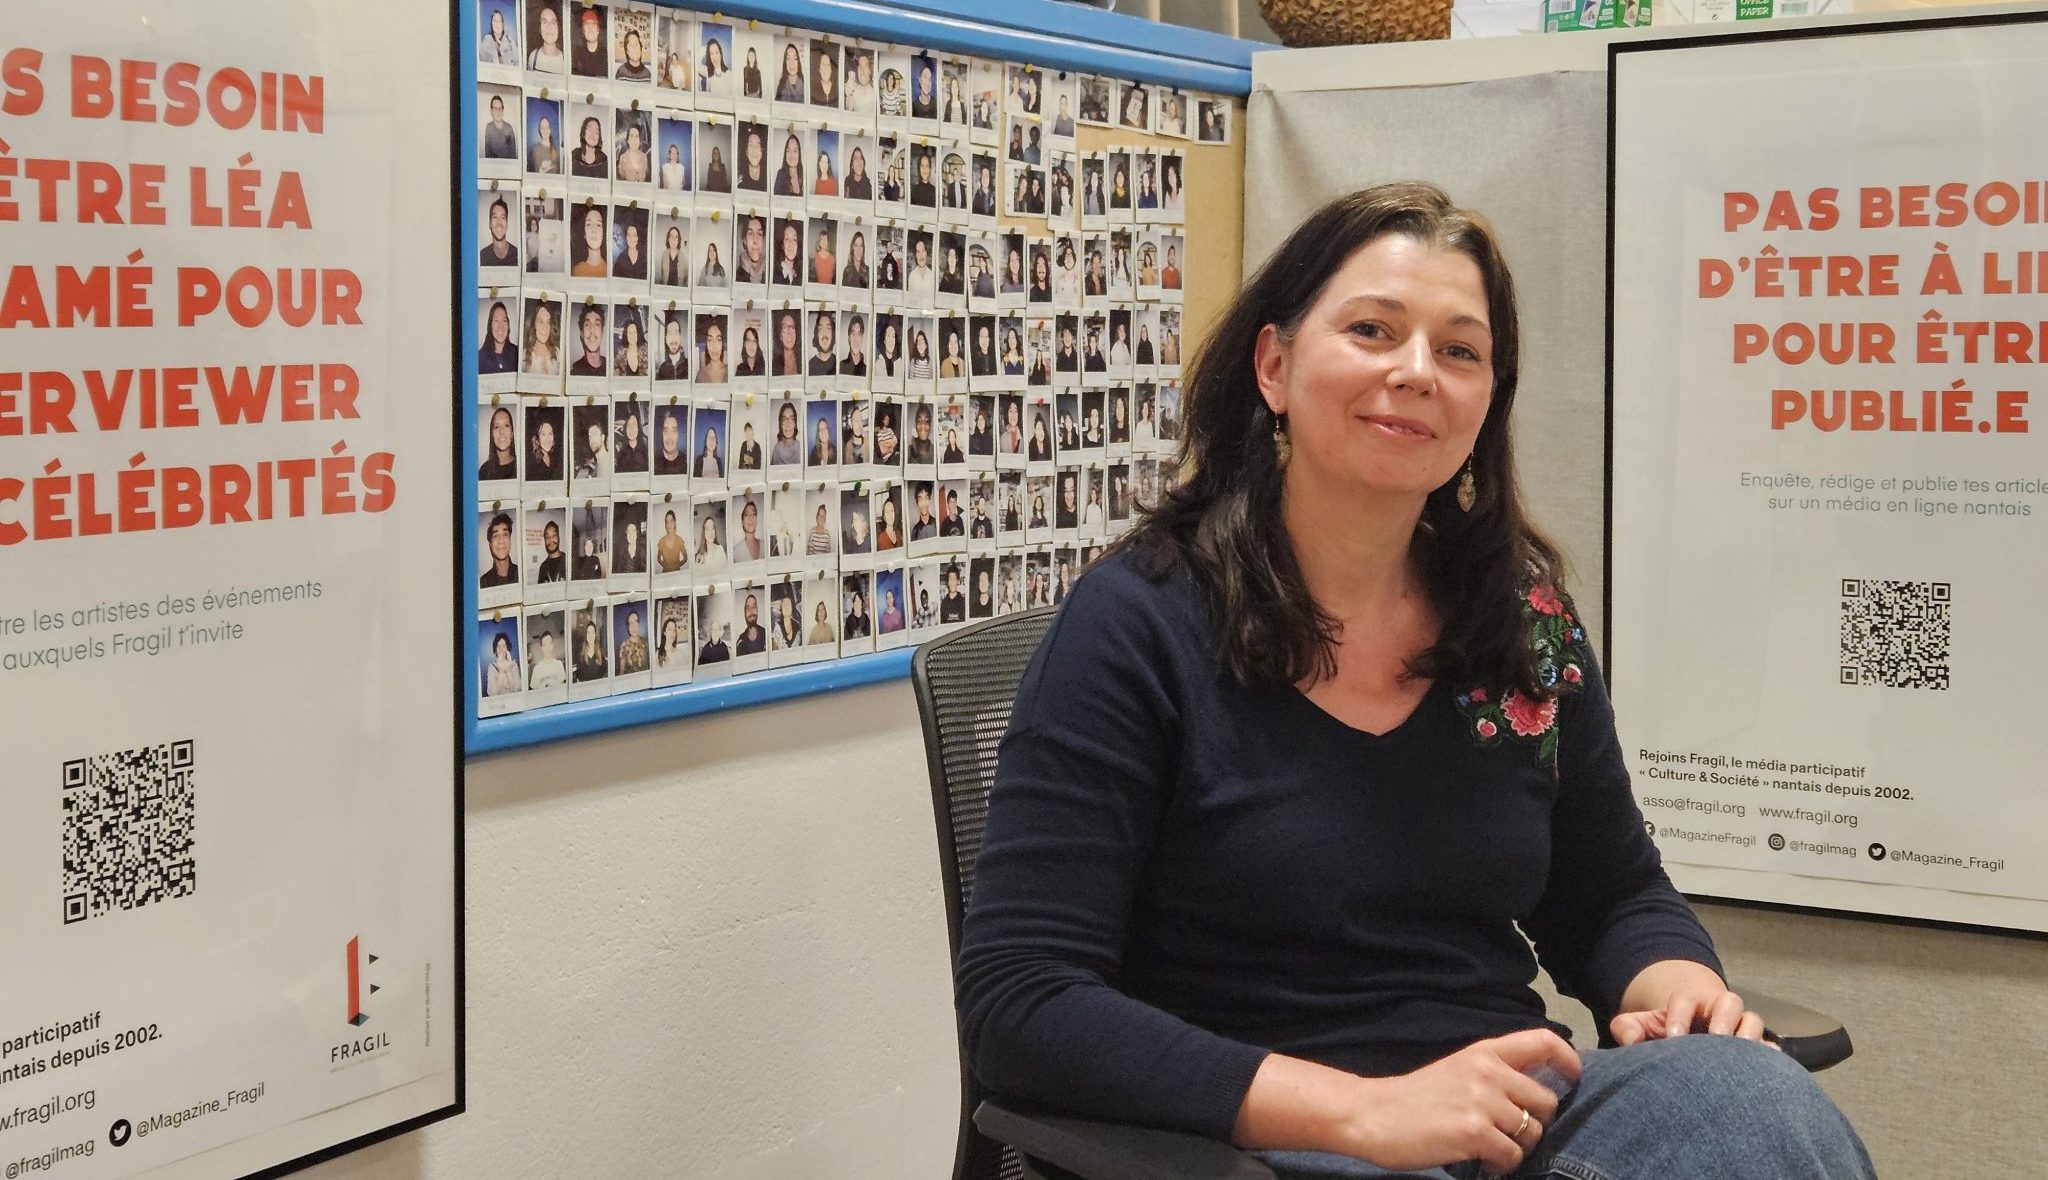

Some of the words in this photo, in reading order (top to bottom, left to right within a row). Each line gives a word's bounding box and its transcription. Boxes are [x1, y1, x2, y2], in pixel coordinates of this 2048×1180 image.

[1740, 7, 1769, 17] PAPER
[71, 54, 324, 134] BESOIN
[190, 151, 312, 229] LÉA
[1724, 187, 1839, 232] PAS
[1860, 181, 2048, 229] BESOI
[1920, 241, 1963, 295] À
[177, 265, 363, 328] POUR
[1734, 322, 1896, 365] POUR
[1771, 378, 2029, 433] PUBLIÉ.E
[1740, 472, 1814, 490] Enquête,
[1820, 474, 1875, 492] rédige
[1881, 477, 1897, 490] et
[1902, 475, 1958, 493] publie
[1963, 476, 1989, 492] tes
[1768, 496, 1795, 511] sur
[1800, 499, 1820, 510] un
[1826, 495, 1882, 511] média
[1887, 499, 1908, 513] en
[1914, 498, 1957, 516] ligne
[1963, 500, 2031, 516] nantais
[33, 609, 64, 632] les
[72, 601, 149, 626] artistes
[157, 595, 196, 616] des
[202, 580, 323, 611] événements
[3, 637, 105, 670] auxquels
[112, 626, 171, 656] Fragil
[1640, 749, 1687, 764] Rejoins
[1690, 753, 1730, 769] Fragil,
[1731, 757, 1743, 768] le
[1746, 758, 1787, 772] média
[1790, 764, 1866, 779] participatif
[1649, 768, 1696, 782] Culture
[1699, 772, 1709, 783] &
[1710, 772, 1760, 788] Société
[1772, 778, 1822, 793] nantais
[1825, 783, 1872, 798] depuis
[1874, 786, 1914, 801] 2002.
[1643, 796, 1746, 818] asso@fragil.org
[1759, 806, 1858, 828] www.fragil.org
[1660, 827, 1757, 847] @MagazineFragil
[1789, 840, 1857, 858] @fragilmag
[1890, 849, 2004, 873] @Magazine_Fragil
[0, 1057, 47, 1085] ntais
[51, 1039, 110, 1068] depuis
[114, 1023, 163, 1051] 2002.
[2, 1011, 101, 1058] participatif
[330, 1031, 391, 1063] FRAGIL
[136, 1081, 265, 1138] @Magazine_Fragil
[5, 1139, 95, 1180] @fragilmag
